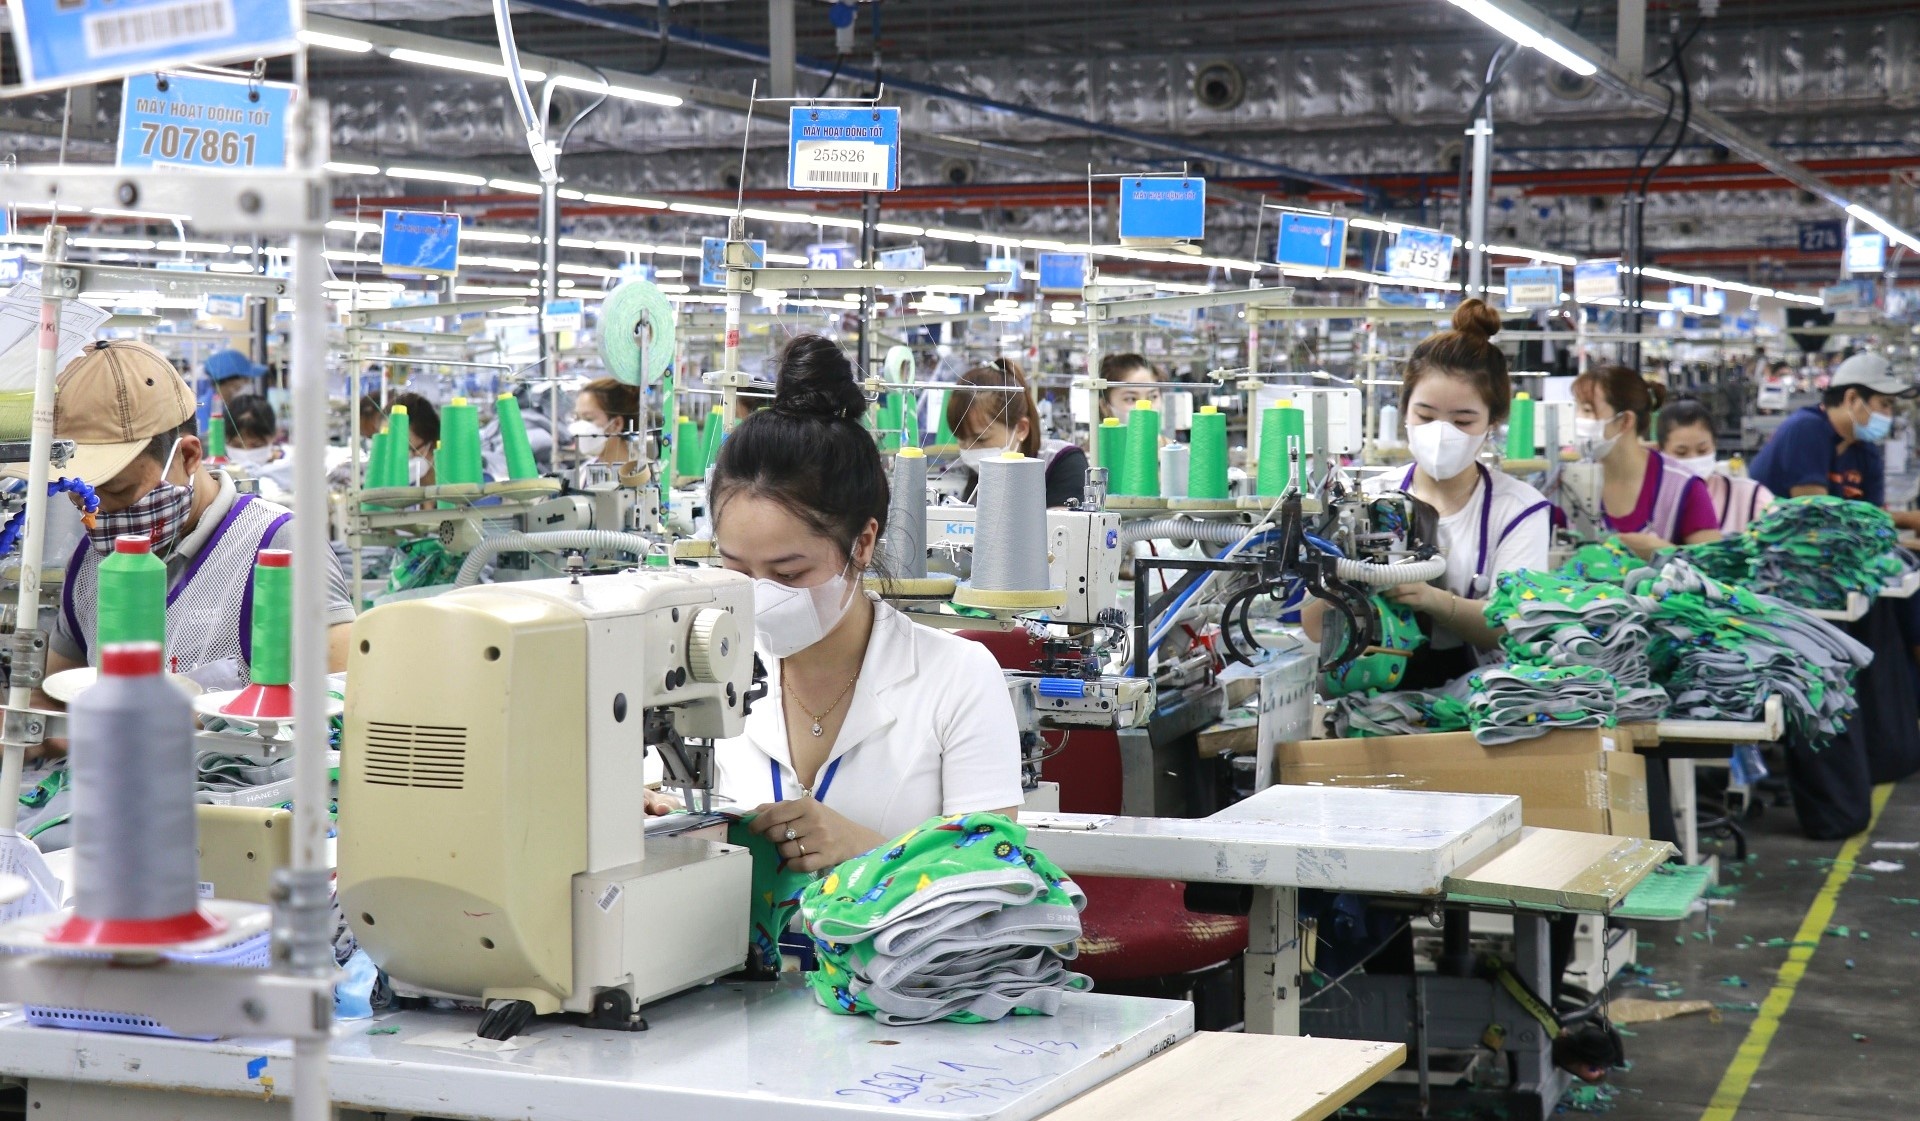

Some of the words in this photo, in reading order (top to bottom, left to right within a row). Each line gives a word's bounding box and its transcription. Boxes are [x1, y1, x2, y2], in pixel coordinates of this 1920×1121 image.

[170, 103, 204, 121] HOẠT
[208, 104, 243, 125] ĐỘNG
[803, 124, 820, 136] MÁY
[822, 126, 844, 138] HOẠT
[845, 125, 867, 138] ĐỘNG
[141, 122, 256, 167] 707861
[814, 148, 865, 162] 255826
[246, 788, 280, 803] HANES
